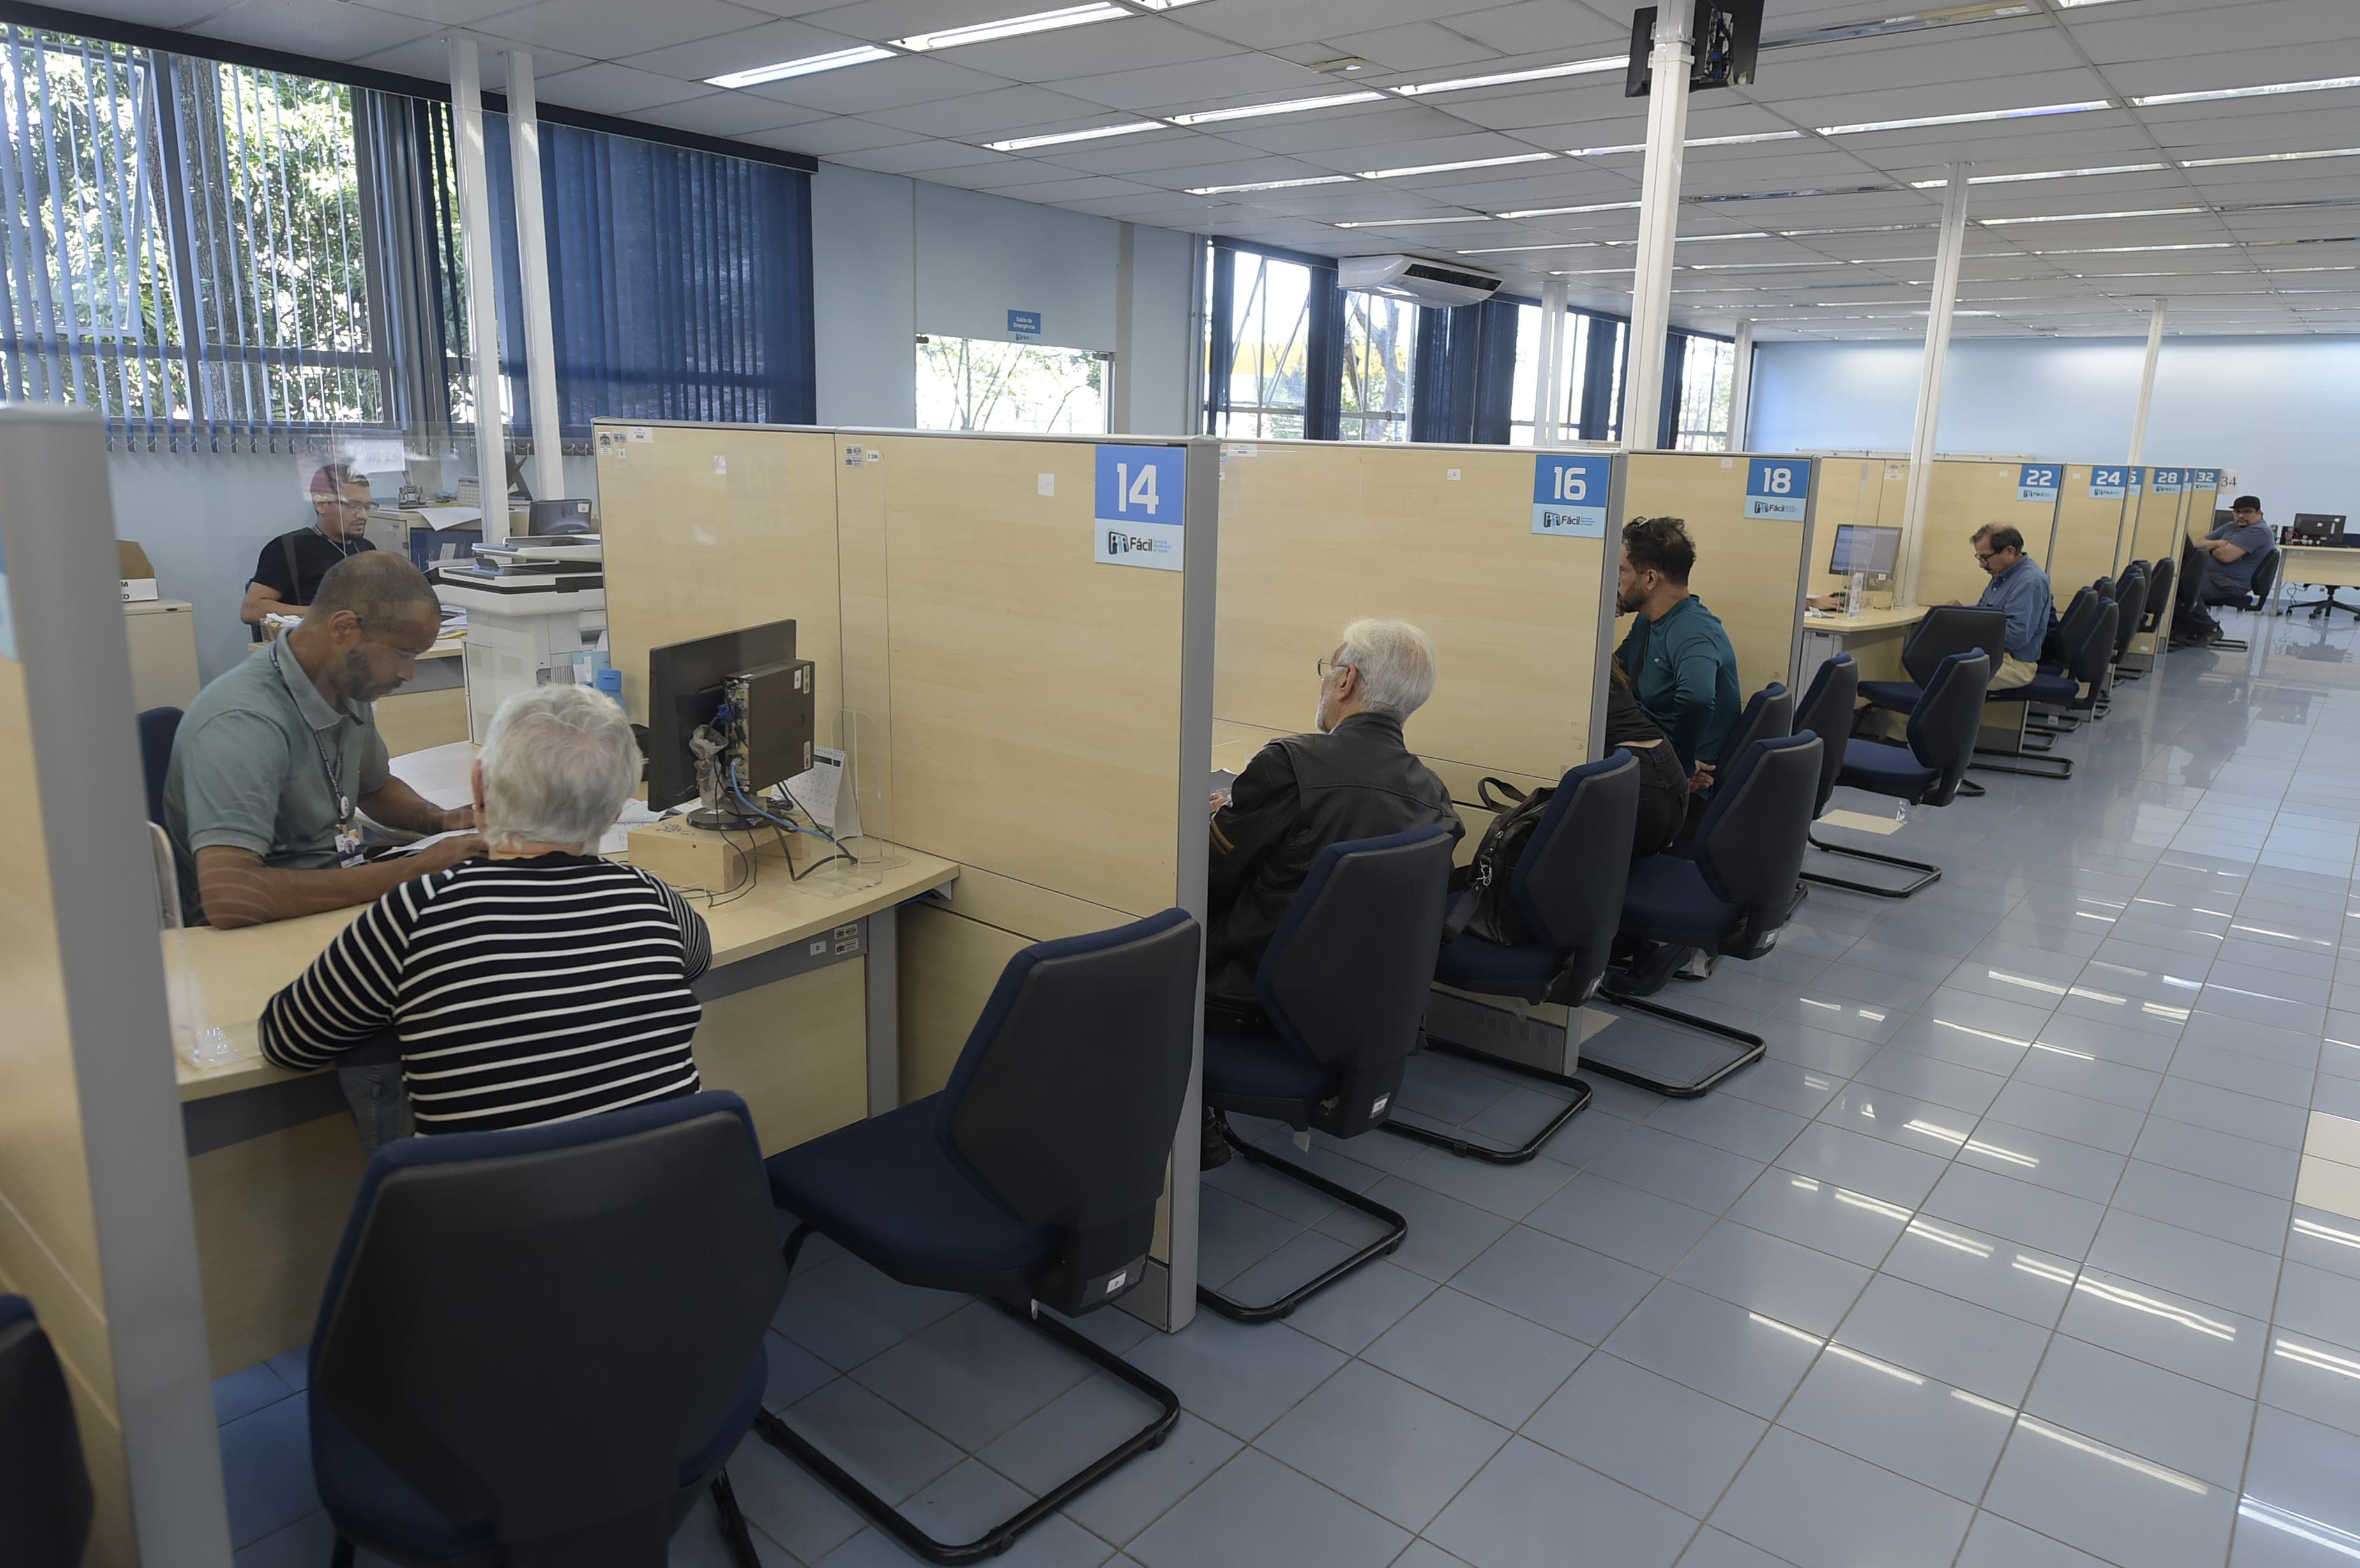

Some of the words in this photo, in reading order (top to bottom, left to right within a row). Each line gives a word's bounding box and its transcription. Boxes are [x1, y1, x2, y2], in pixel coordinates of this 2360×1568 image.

[1554, 466, 1587, 501] 16
[1763, 467, 1792, 494] 18
[2026, 469, 2053, 486] 22
[2096, 470, 2121, 485] 24
[2158, 471, 2177, 483] 28
[2197, 471, 2214, 482] 32
[2220, 476, 2237, 487] 34
[1117, 463, 1160, 515] 14
[1769, 504, 1785, 512] Fácil
[1561, 515, 1580, 525] Fácil
[1130, 537, 1153, 552] Fácil
